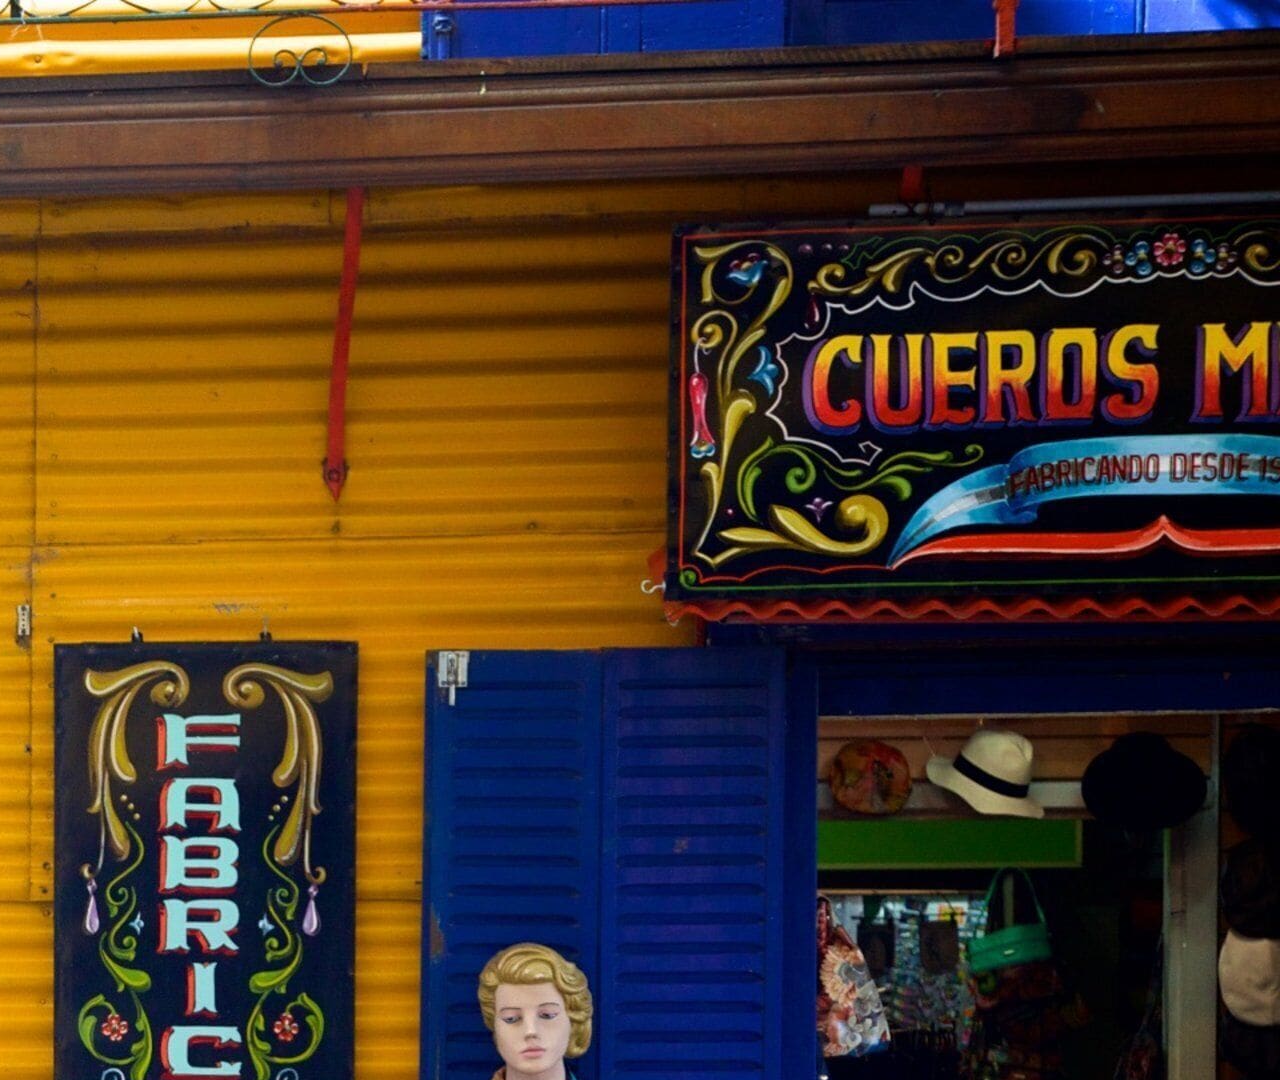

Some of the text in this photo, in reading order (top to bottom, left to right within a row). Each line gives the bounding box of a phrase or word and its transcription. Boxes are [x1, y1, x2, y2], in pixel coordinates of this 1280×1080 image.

[804, 320, 1280, 433] CUEROS M
[1008, 452, 1161, 497] FABRICANDO
[1170, 452, 1251, 483] DESDE
